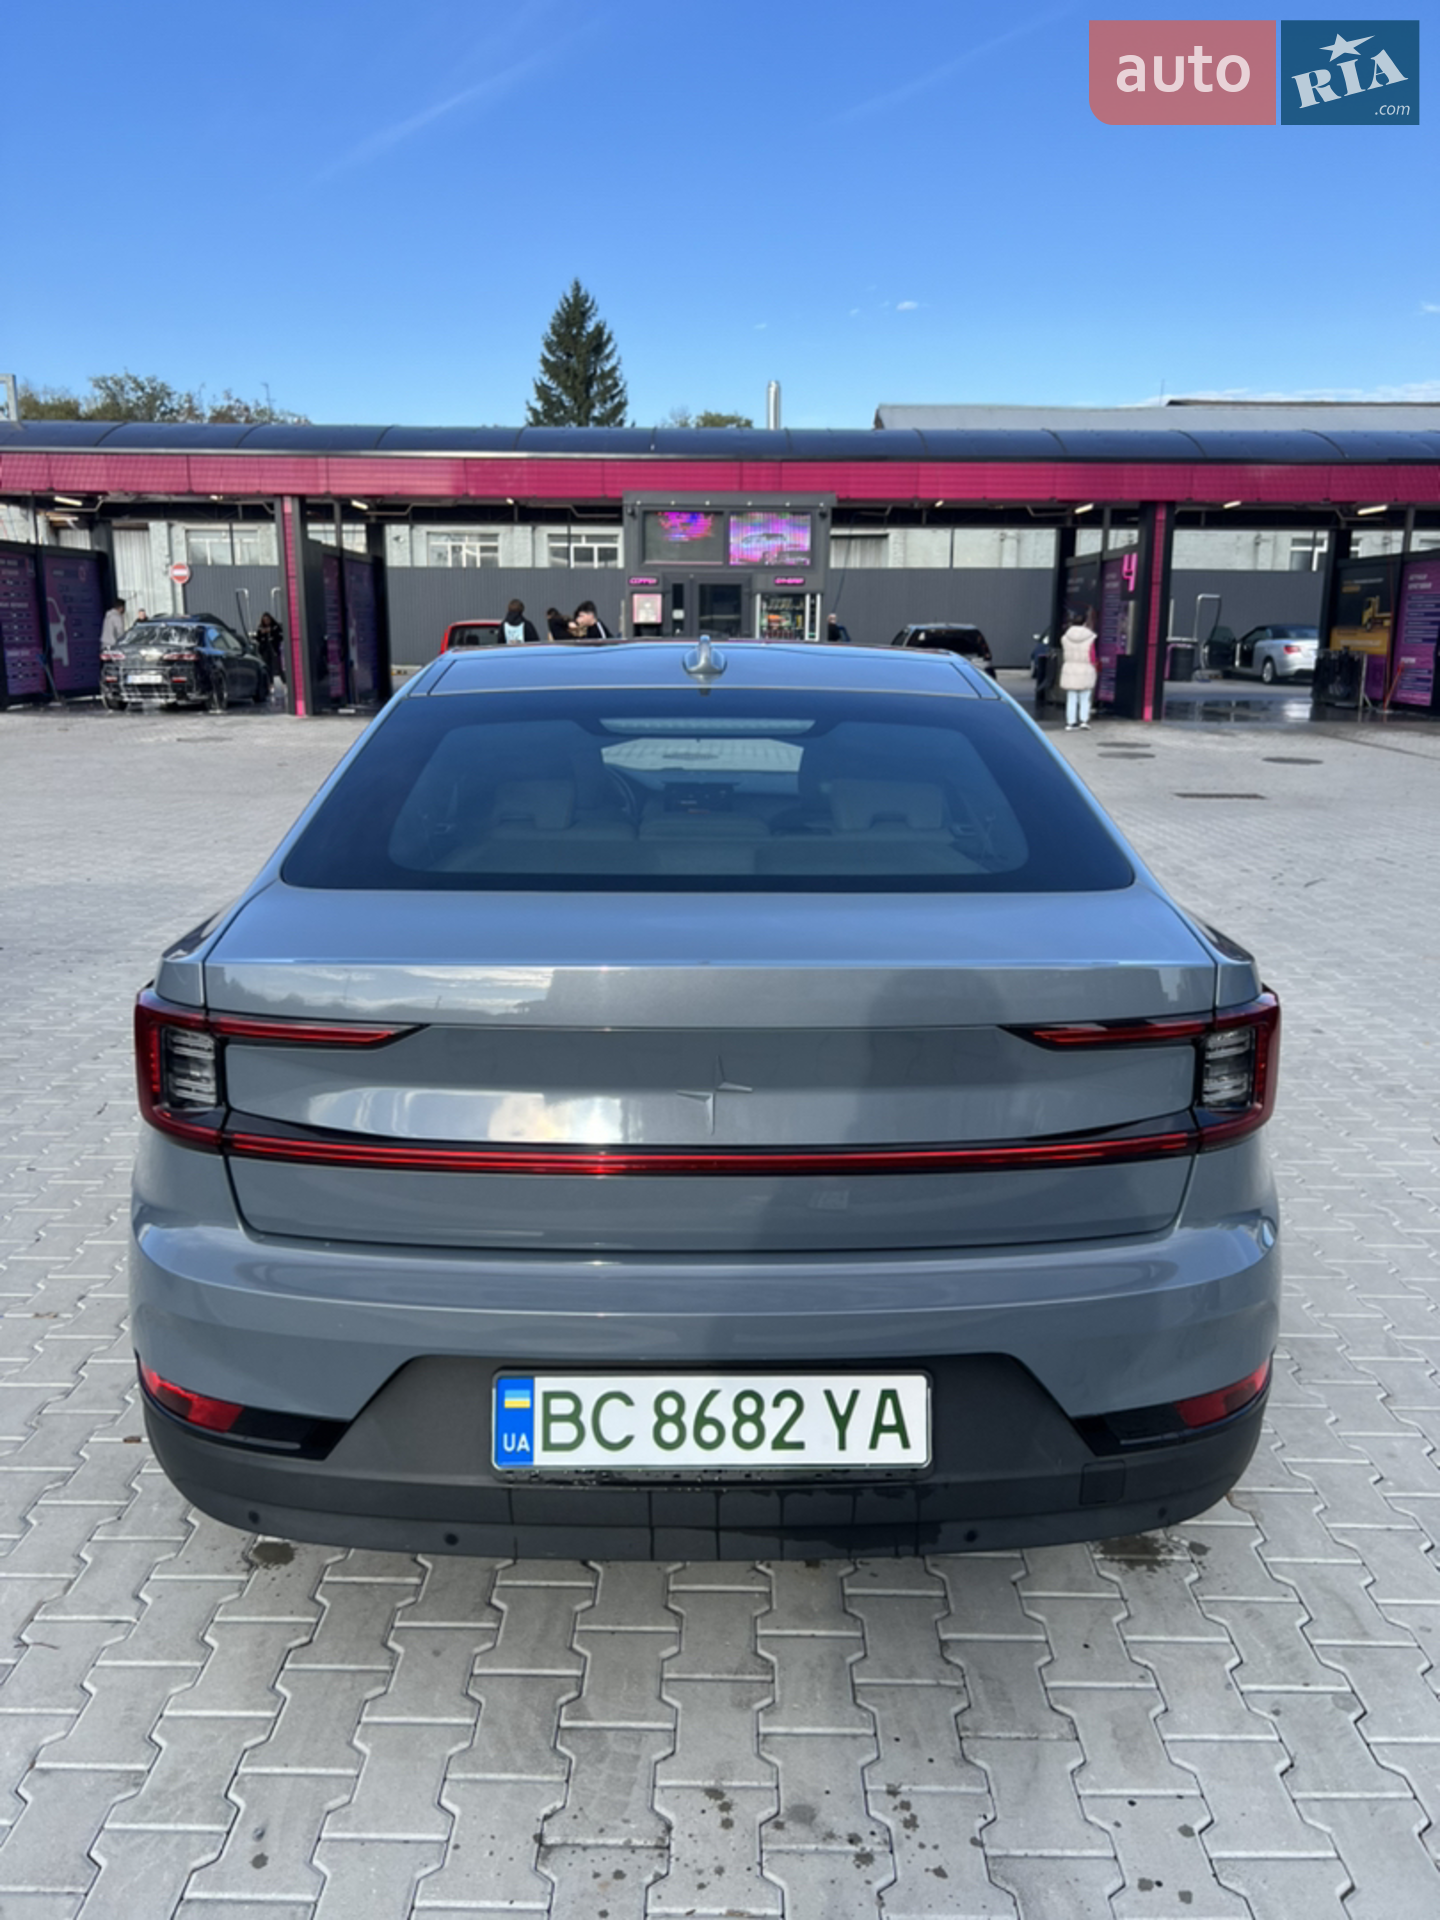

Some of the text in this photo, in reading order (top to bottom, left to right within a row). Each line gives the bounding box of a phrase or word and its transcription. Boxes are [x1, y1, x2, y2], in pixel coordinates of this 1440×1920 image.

[1122, 552, 1138, 592] 4
[541, 1388, 911, 1452] BC 8682 YA
[503, 1433, 531, 1453] UA
